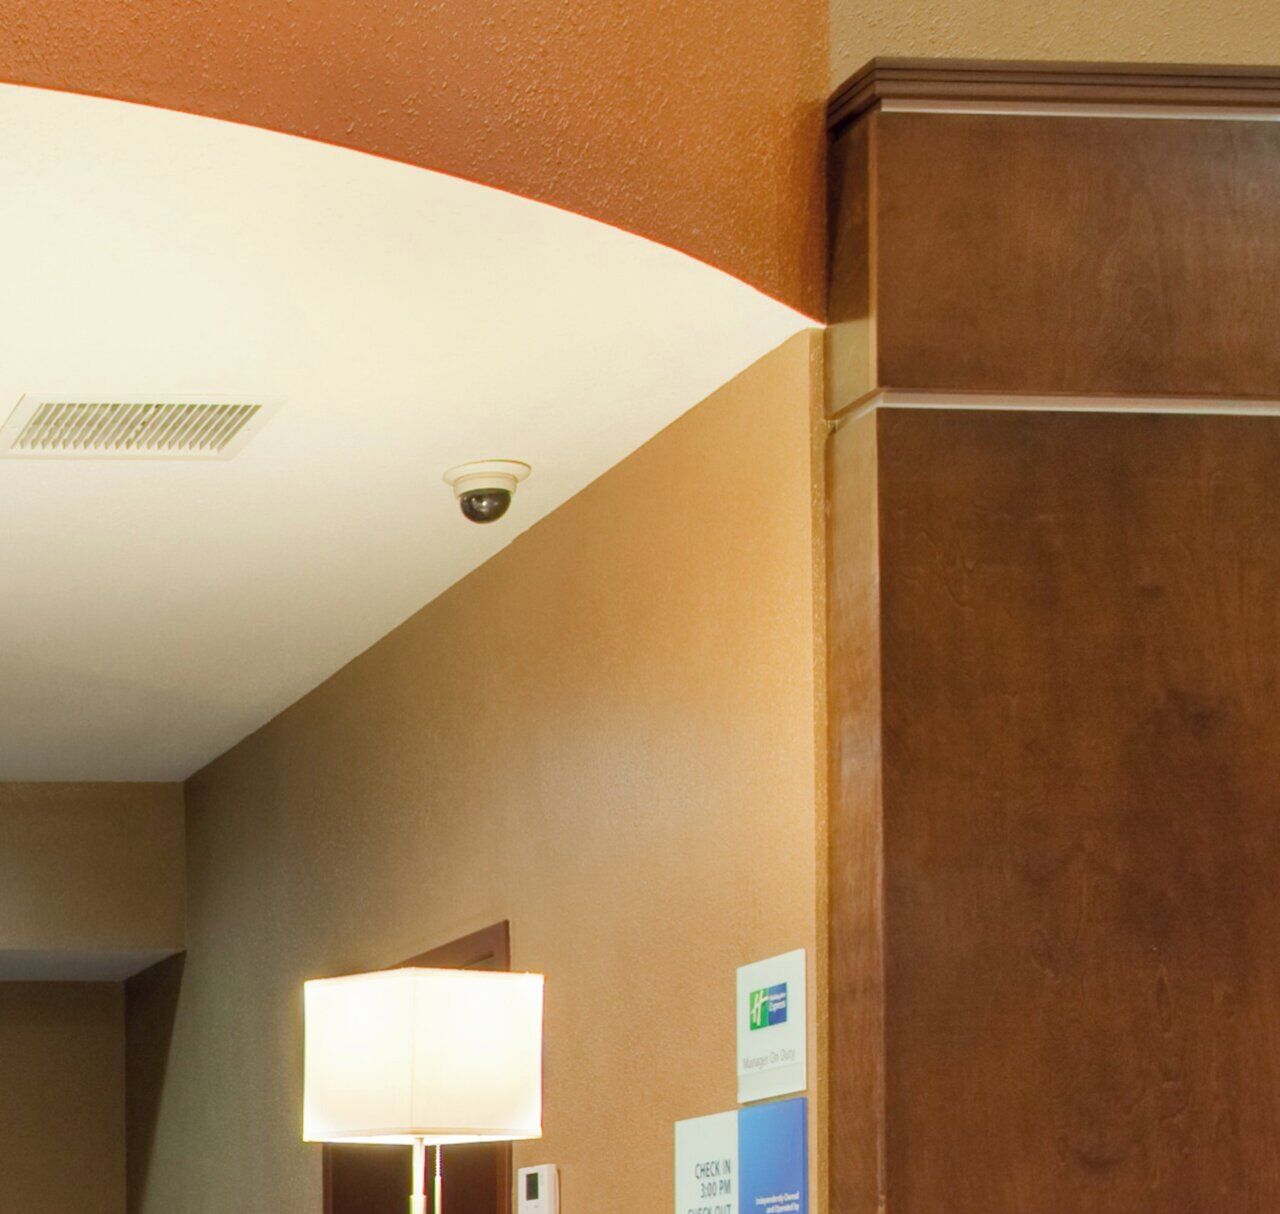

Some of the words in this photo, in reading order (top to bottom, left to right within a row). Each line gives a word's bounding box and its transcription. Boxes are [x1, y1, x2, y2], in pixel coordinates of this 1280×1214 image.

[743, 1055, 768, 1070] Manager
[769, 1051, 779, 1063] On
[780, 1048, 796, 1061] Duty
[695, 1160, 720, 1179] CHECK
[722, 1159, 731, 1175] IN
[700, 1181, 717, 1198] 3:00
[719, 1179, 731, 1195] PM
